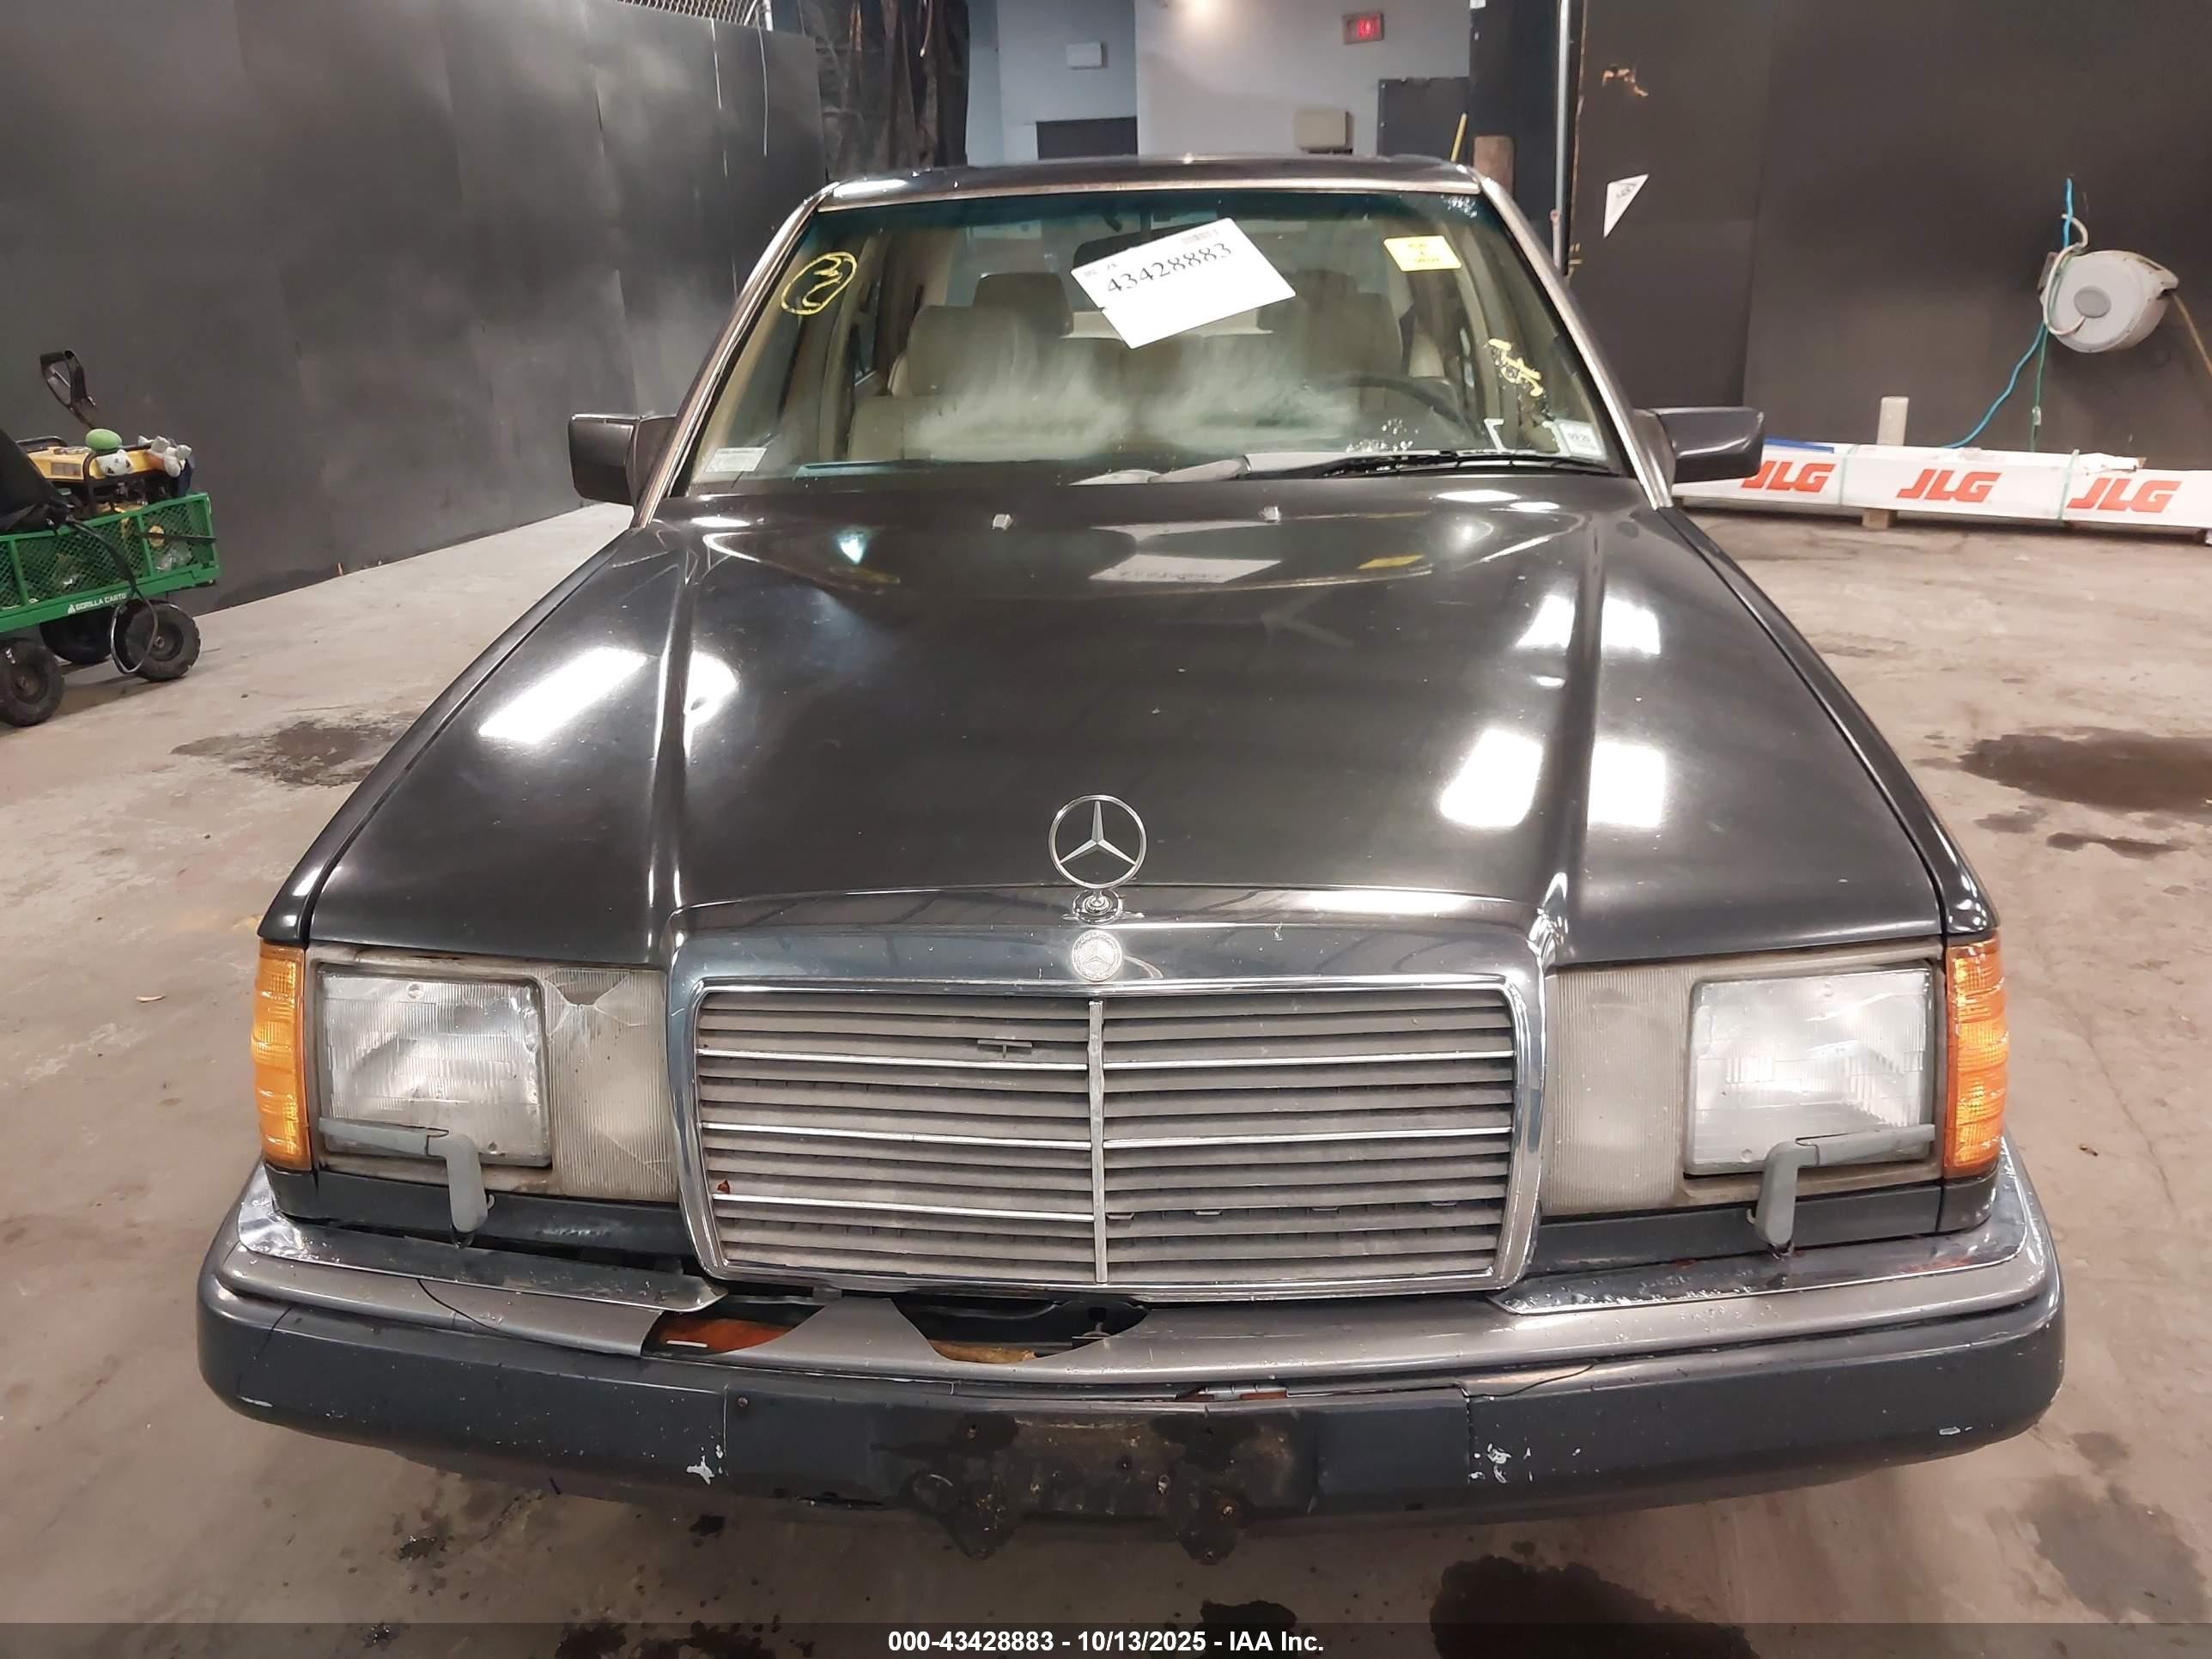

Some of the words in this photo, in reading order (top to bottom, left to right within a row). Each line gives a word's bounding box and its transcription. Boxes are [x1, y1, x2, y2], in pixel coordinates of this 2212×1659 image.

[1107, 242, 1232, 293] 43428883
[1741, 460, 1836, 493] JLG
[1896, 468, 2003, 503] JLG
[2066, 477, 2184, 514] JLG
[75, 599, 104, 611] GORILLA
